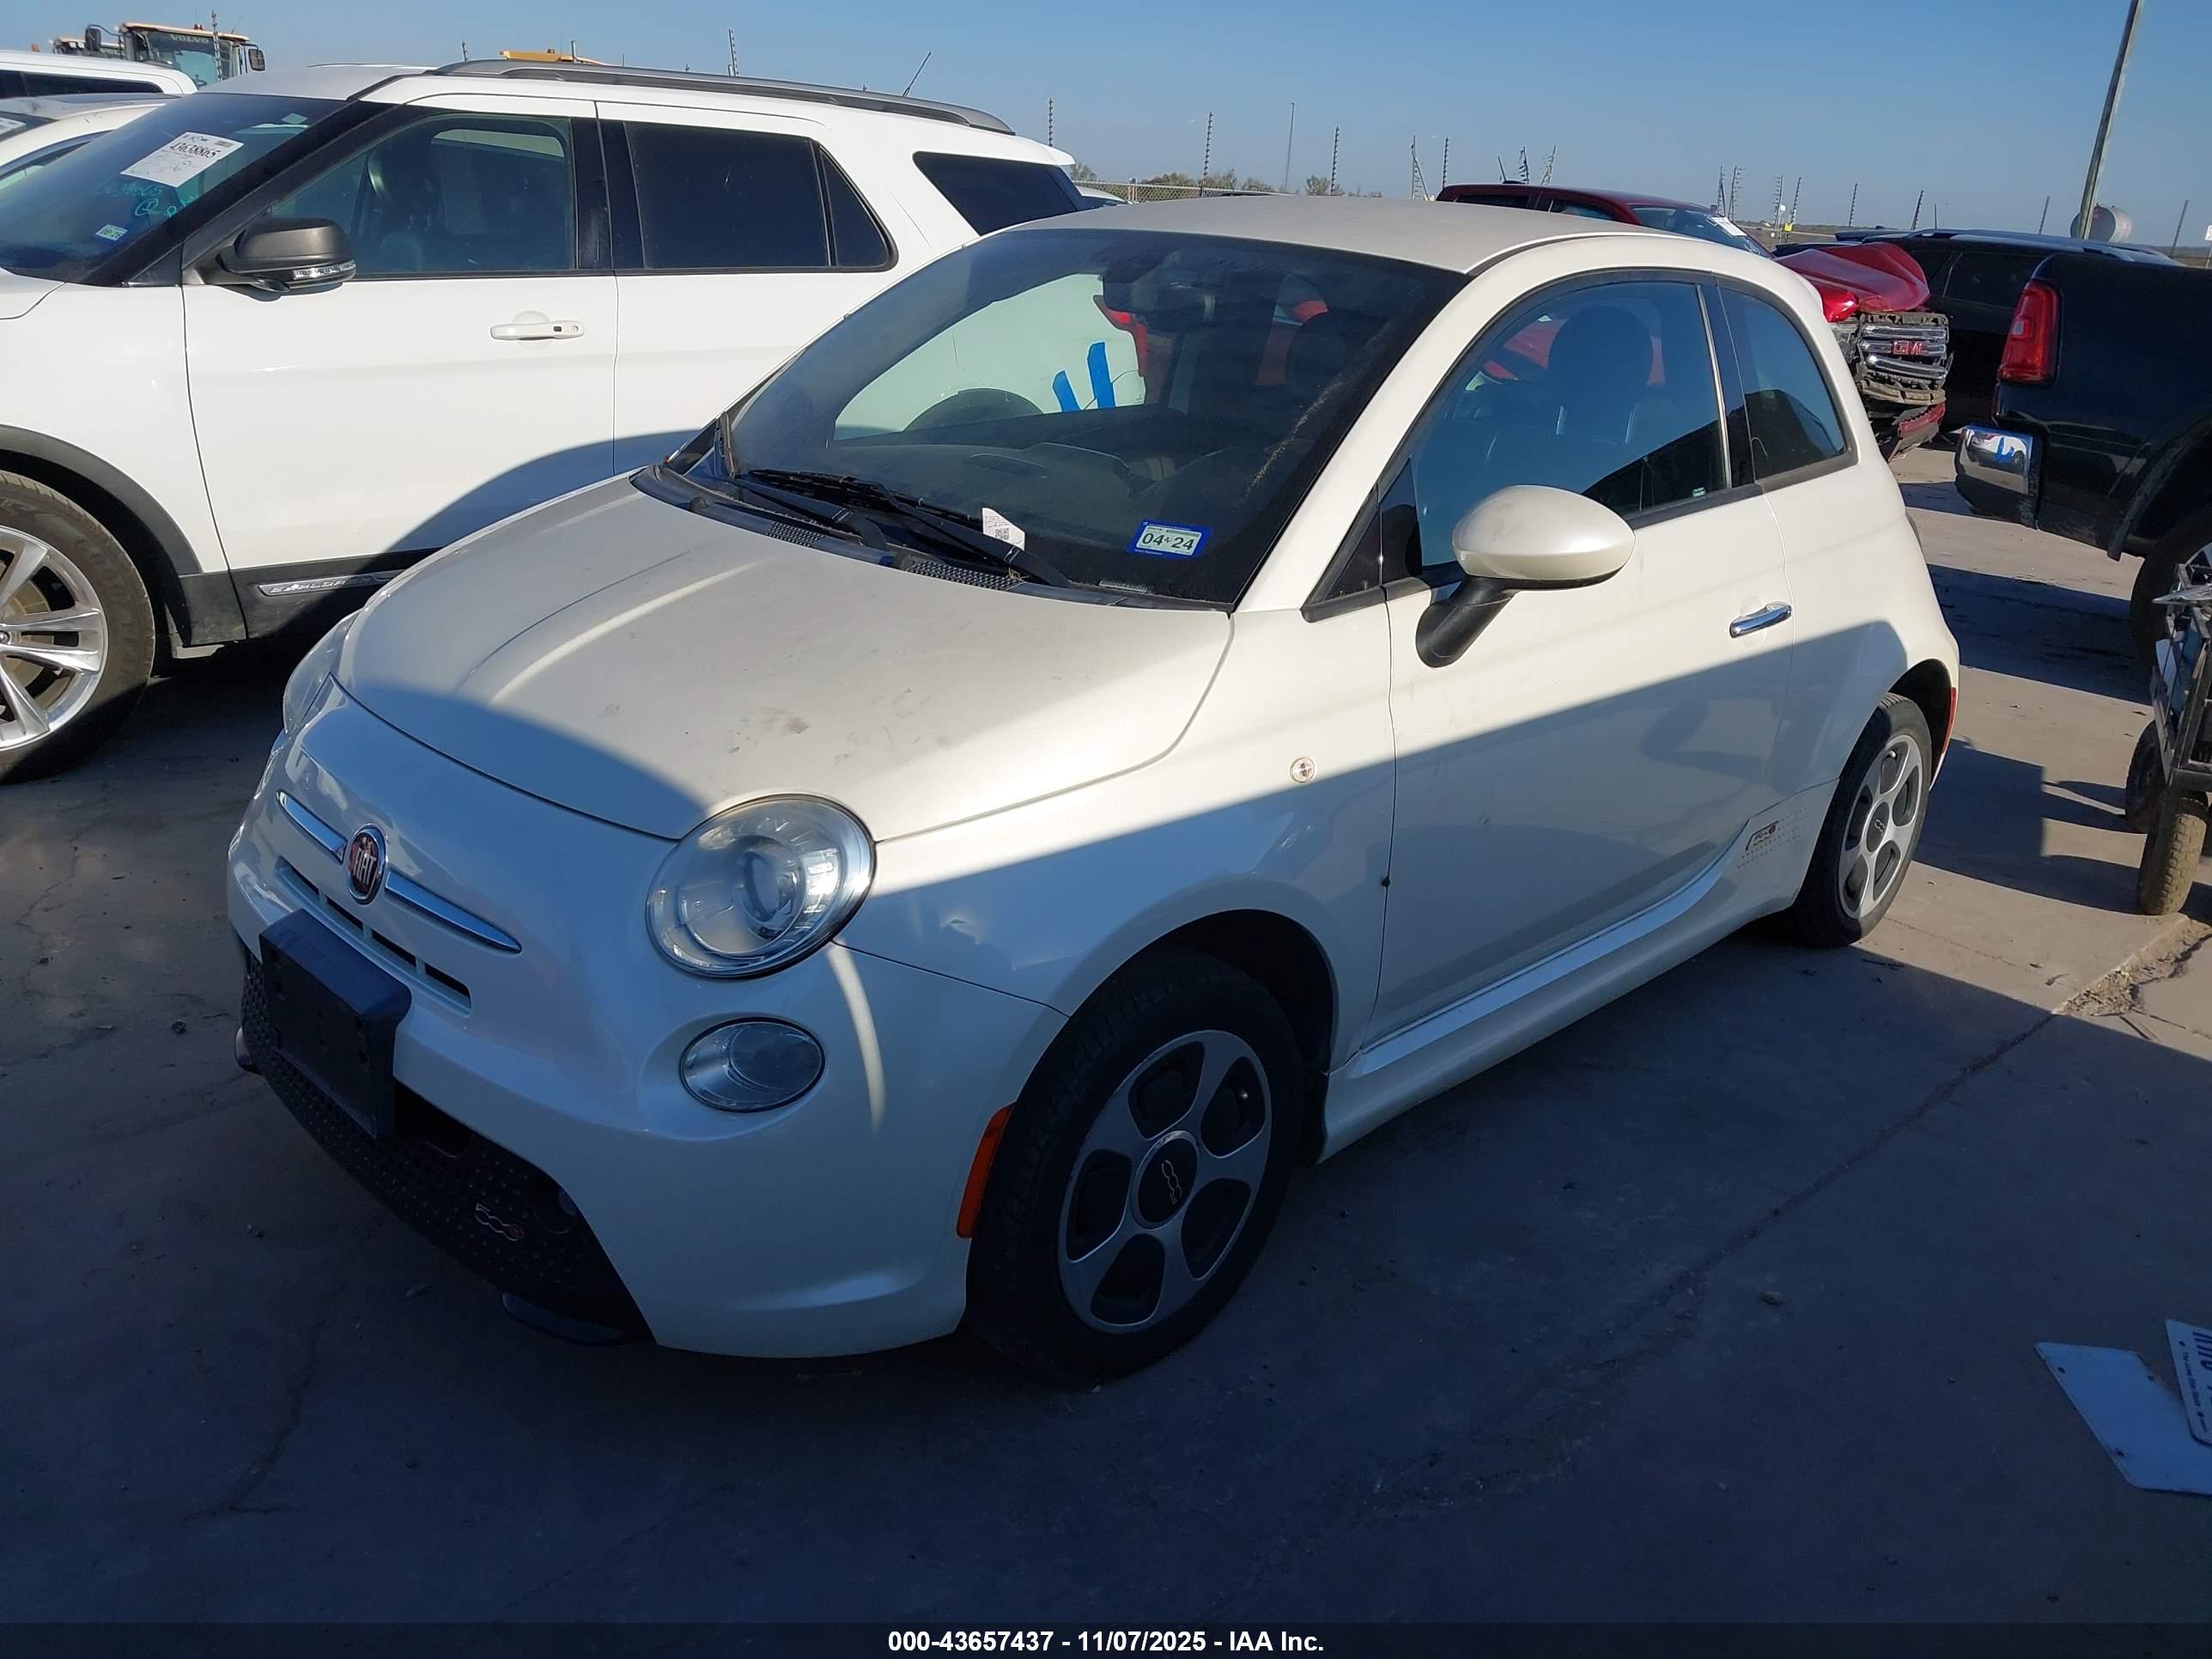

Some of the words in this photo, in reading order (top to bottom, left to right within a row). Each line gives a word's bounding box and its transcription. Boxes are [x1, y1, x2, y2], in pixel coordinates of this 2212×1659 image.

[169, 33, 210, 44] VOLVO
[1142, 532, 1165, 546] 04
[1170, 537, 1194, 550] 24
